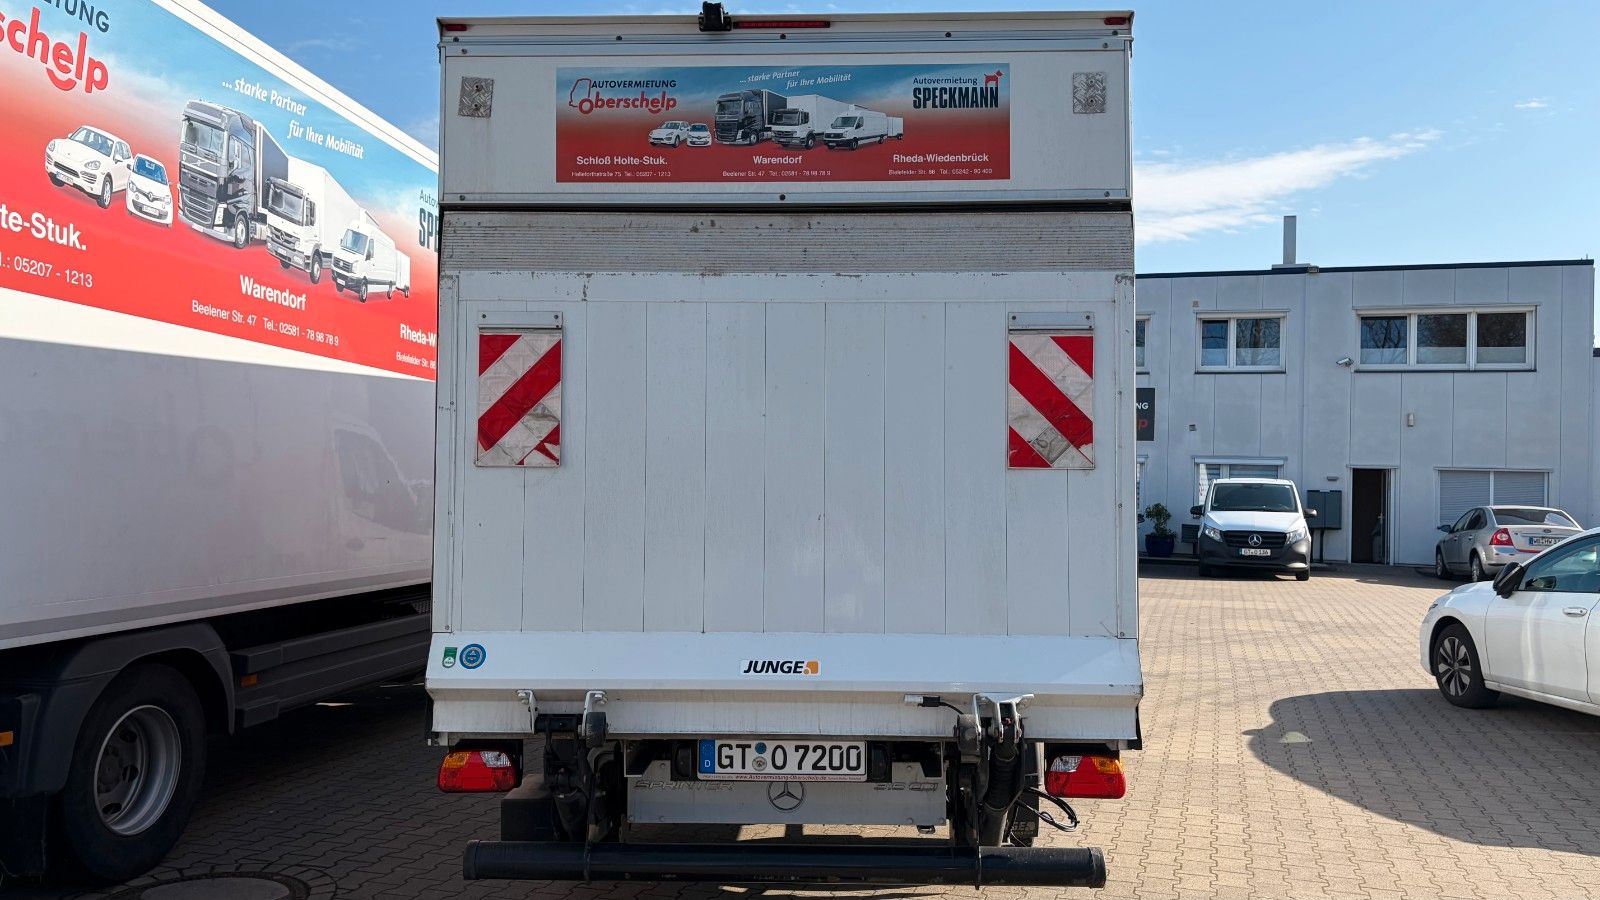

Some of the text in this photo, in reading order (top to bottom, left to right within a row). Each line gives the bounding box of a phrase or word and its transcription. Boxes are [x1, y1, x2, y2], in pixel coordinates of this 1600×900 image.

[772, 71, 800, 79] Partner
[786, 80, 798, 90] für
[816, 74, 851, 84] Mobilität
[592, 80, 677, 88] AUTOVERMIETUNG
[235, 77, 267, 102] starke
[270, 90, 307, 116] Partner
[913, 87, 998, 109] SPECKMANN
[287, 119, 364, 159] für Ihre Mobilität
[576, 156, 668, 165] Schloß Holte-Stuk.
[753, 156, 802, 164] Warendorf
[893, 153, 989, 162] Rheda-Wiedenbrück
[14, 256, 52, 277] 05207
[65, 268, 93, 287] 1213
[239, 274, 306, 310] Warendorf
[191, 299, 230, 320] Beelener
[232, 310, 245, 324] Str.
[247, 315, 257, 326] 47
[262, 317, 278, 332] Tel.:
[279, 322, 300, 337] 02581
[743, 660, 804, 674] JUNGE
[717, 744, 751, 770] GT
[795, 745, 861, 771] 7200
[634, 780, 734, 791] SPRINTER
